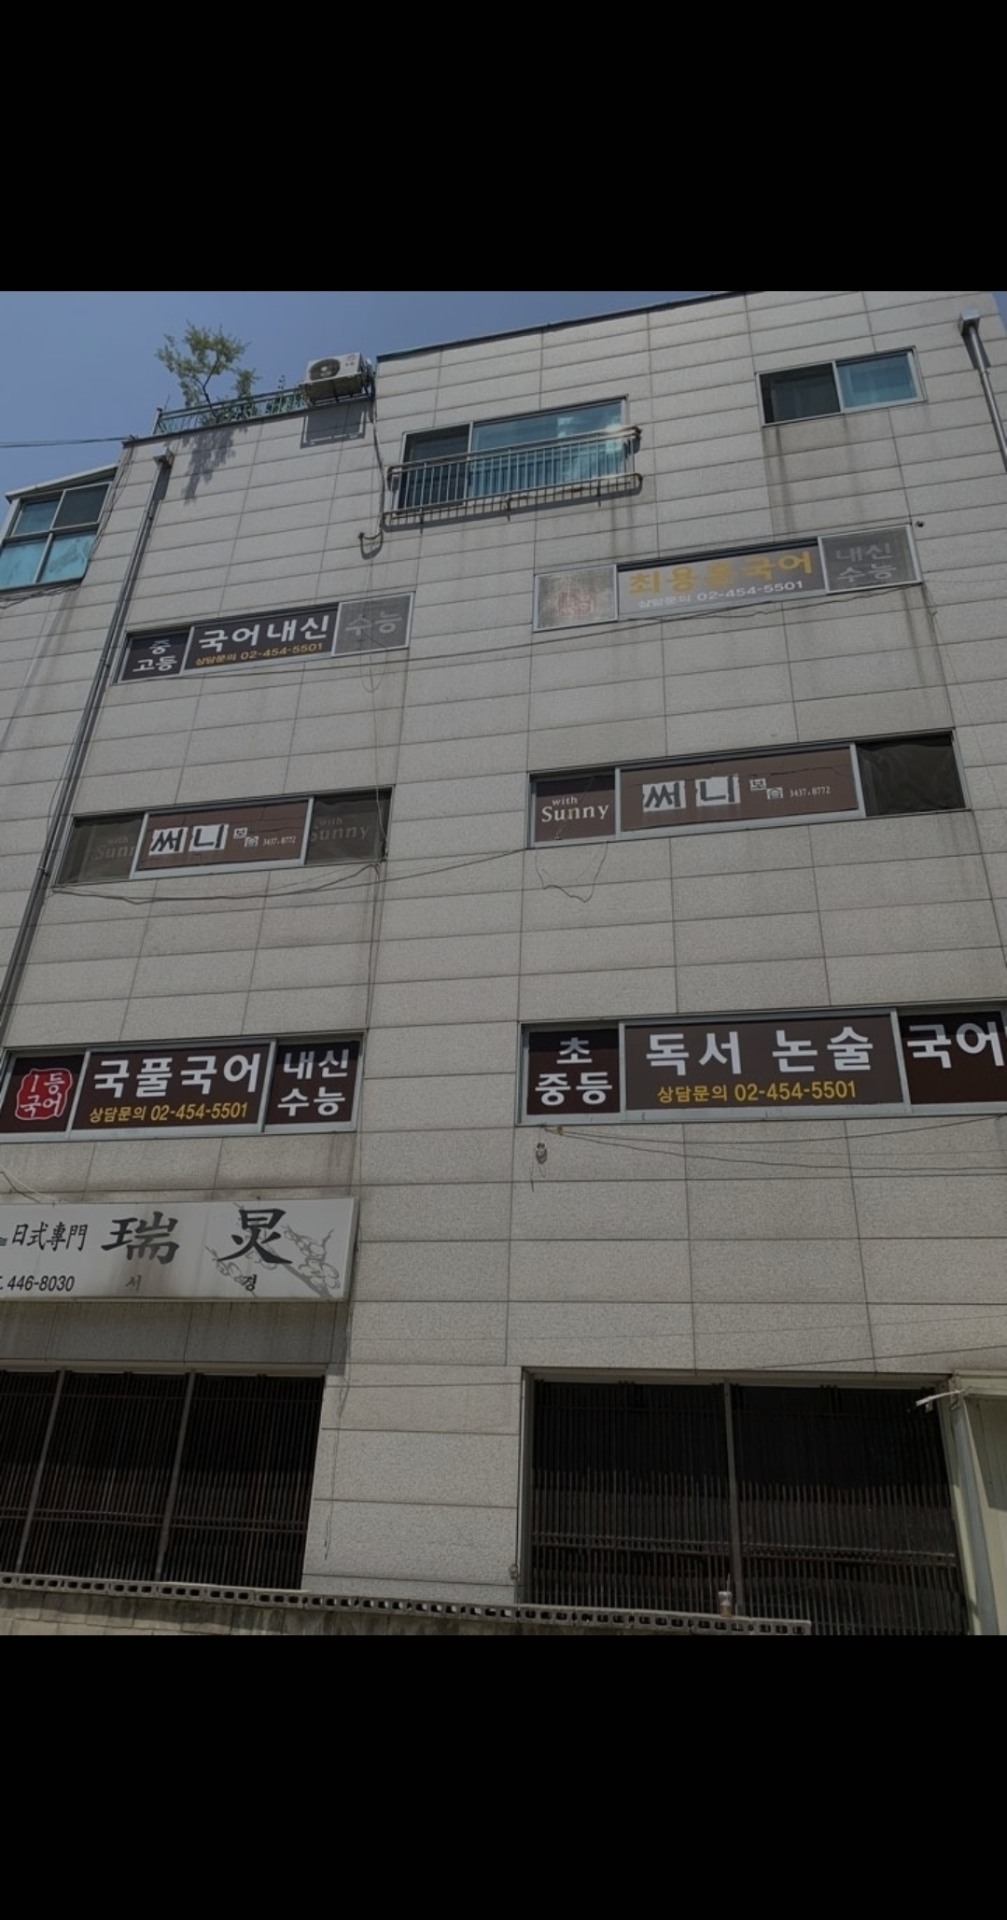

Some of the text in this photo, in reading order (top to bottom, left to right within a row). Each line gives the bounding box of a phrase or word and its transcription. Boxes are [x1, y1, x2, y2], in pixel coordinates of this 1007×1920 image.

[836, 543, 894, 562] 내신
[837, 563, 897, 583] 수능
[696, 580, 804, 602] 02-454-5501
[344, 609, 403, 636] 수능
[148, 639, 172, 655] 중
[240, 642, 324, 661] 02-454-5501
[132, 654, 179, 673] 고등
[551, 796, 578, 806] with
[643, 775, 738, 809] 써니
[541, 804, 610, 823] Sunny
[149, 823, 227, 854] 써니
[556, 1036, 593, 1066] 초
[645, 1026, 875, 1076] 독서 논술
[906, 1021, 1005, 1069] 국어
[93, 1053, 261, 1099] 국풀국어
[283, 1048, 350, 1081] 내신
[534, 1070, 613, 1106] 중등
[656, 1080, 857, 1105] 상담문의 02-454-5501
[20, 1093, 63, 1119] 국어
[89, 1101, 249, 1124] 상담문의 02-454-5501
[277, 1086, 346, 1118] 수능
[7, 1274, 75, 1292] 446-8030
